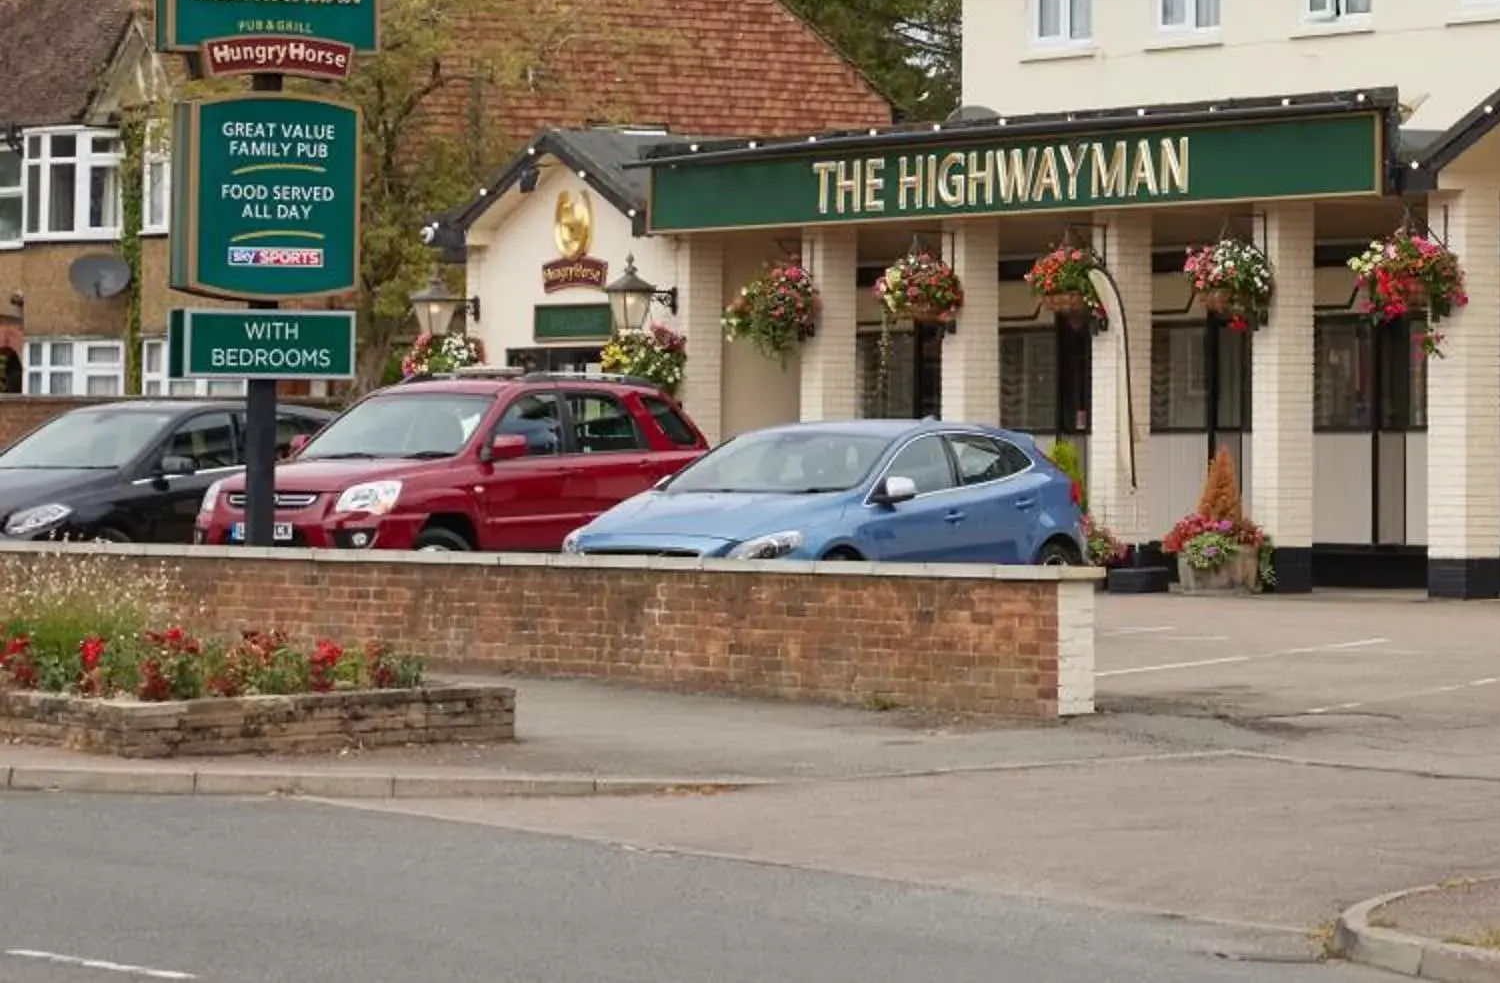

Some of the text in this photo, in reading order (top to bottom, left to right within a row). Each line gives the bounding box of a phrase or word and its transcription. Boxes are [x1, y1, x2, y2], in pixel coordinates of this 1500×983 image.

[239, 20, 314, 34] PUB & GRILL
[221, 121, 336, 140] GREAT VALUE
[229, 140, 329, 158] FAMILY PUB
[813, 136, 1190, 214] THE HIGHWAYMAN
[221, 184, 335, 202] FOOD SERVED
[241, 203, 313, 220] ALL DAY
[258, 251, 319, 264] SPORTS
[244, 321, 300, 341] WITH
[211, 347, 332, 368] BEDROOMS
